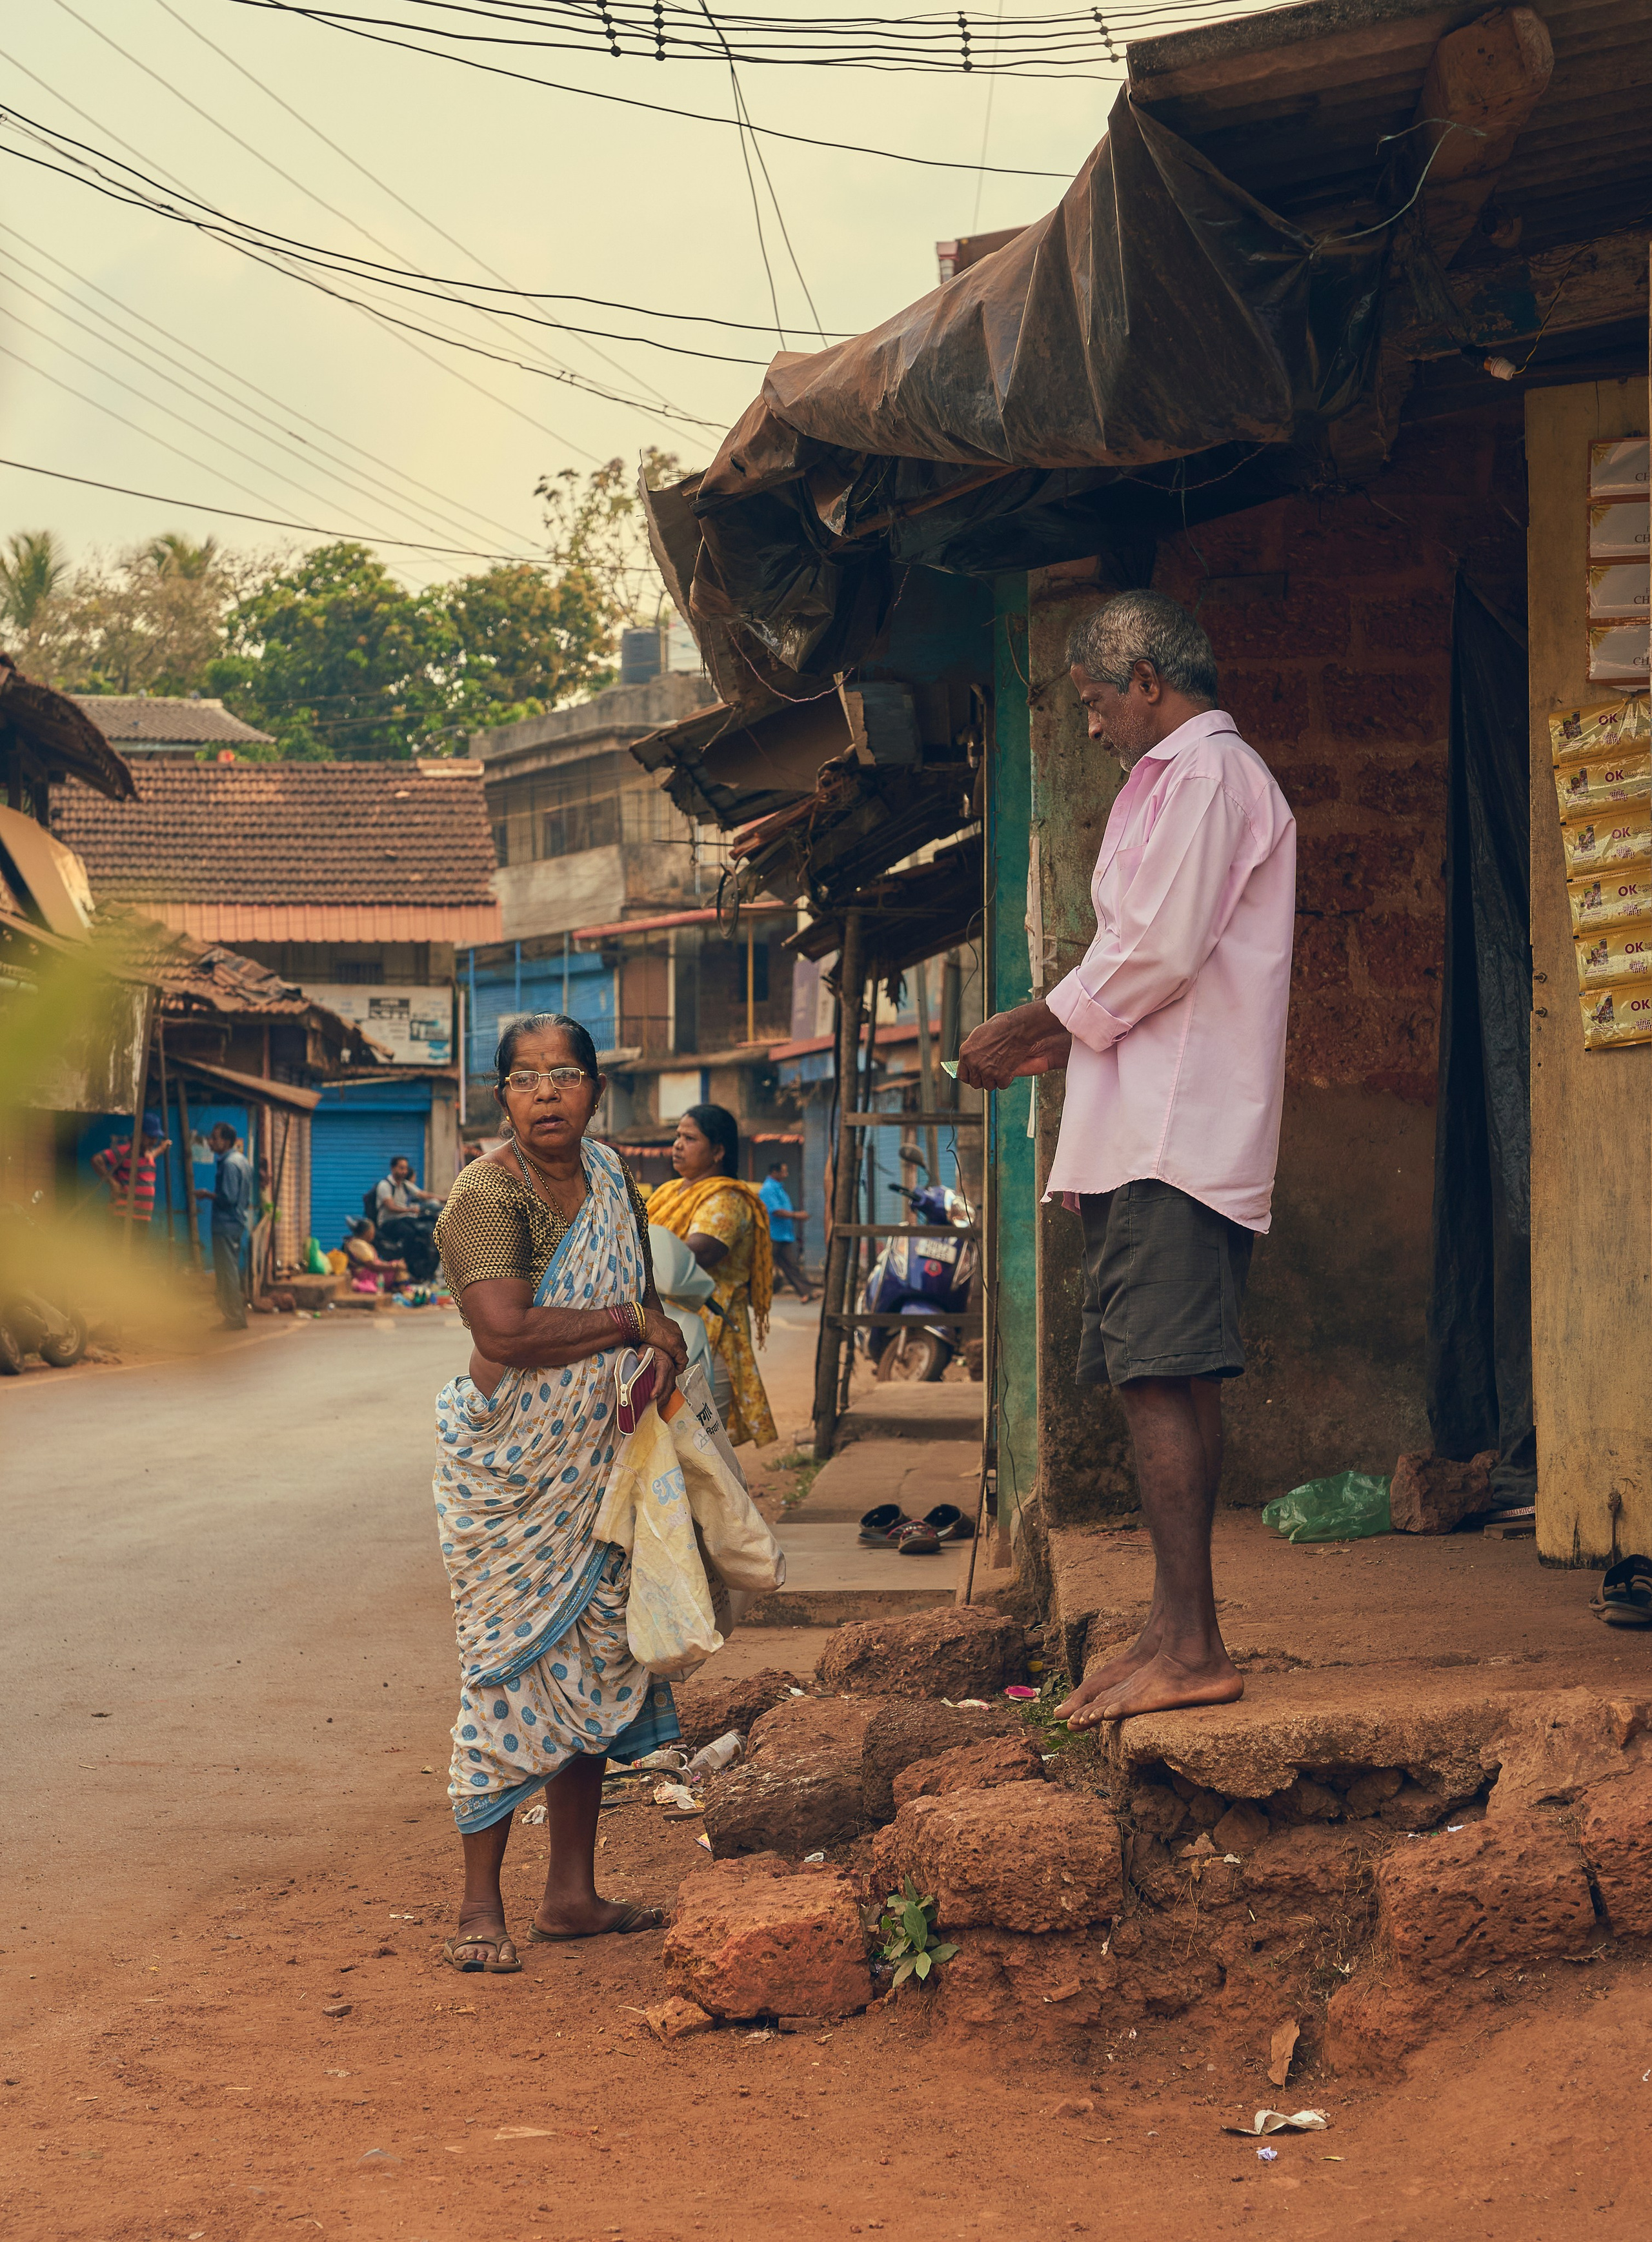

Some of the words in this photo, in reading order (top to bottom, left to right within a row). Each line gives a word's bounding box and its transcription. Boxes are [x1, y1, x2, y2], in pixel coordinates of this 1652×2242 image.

[1598, 712, 1618, 725] OK
[1605, 769, 1625, 783] OK
[1611, 826, 1631, 840] OK
[1618, 884, 1638, 897] OK
[1625, 941, 1644, 954] OK
[1631, 998, 1651, 1011] OK
